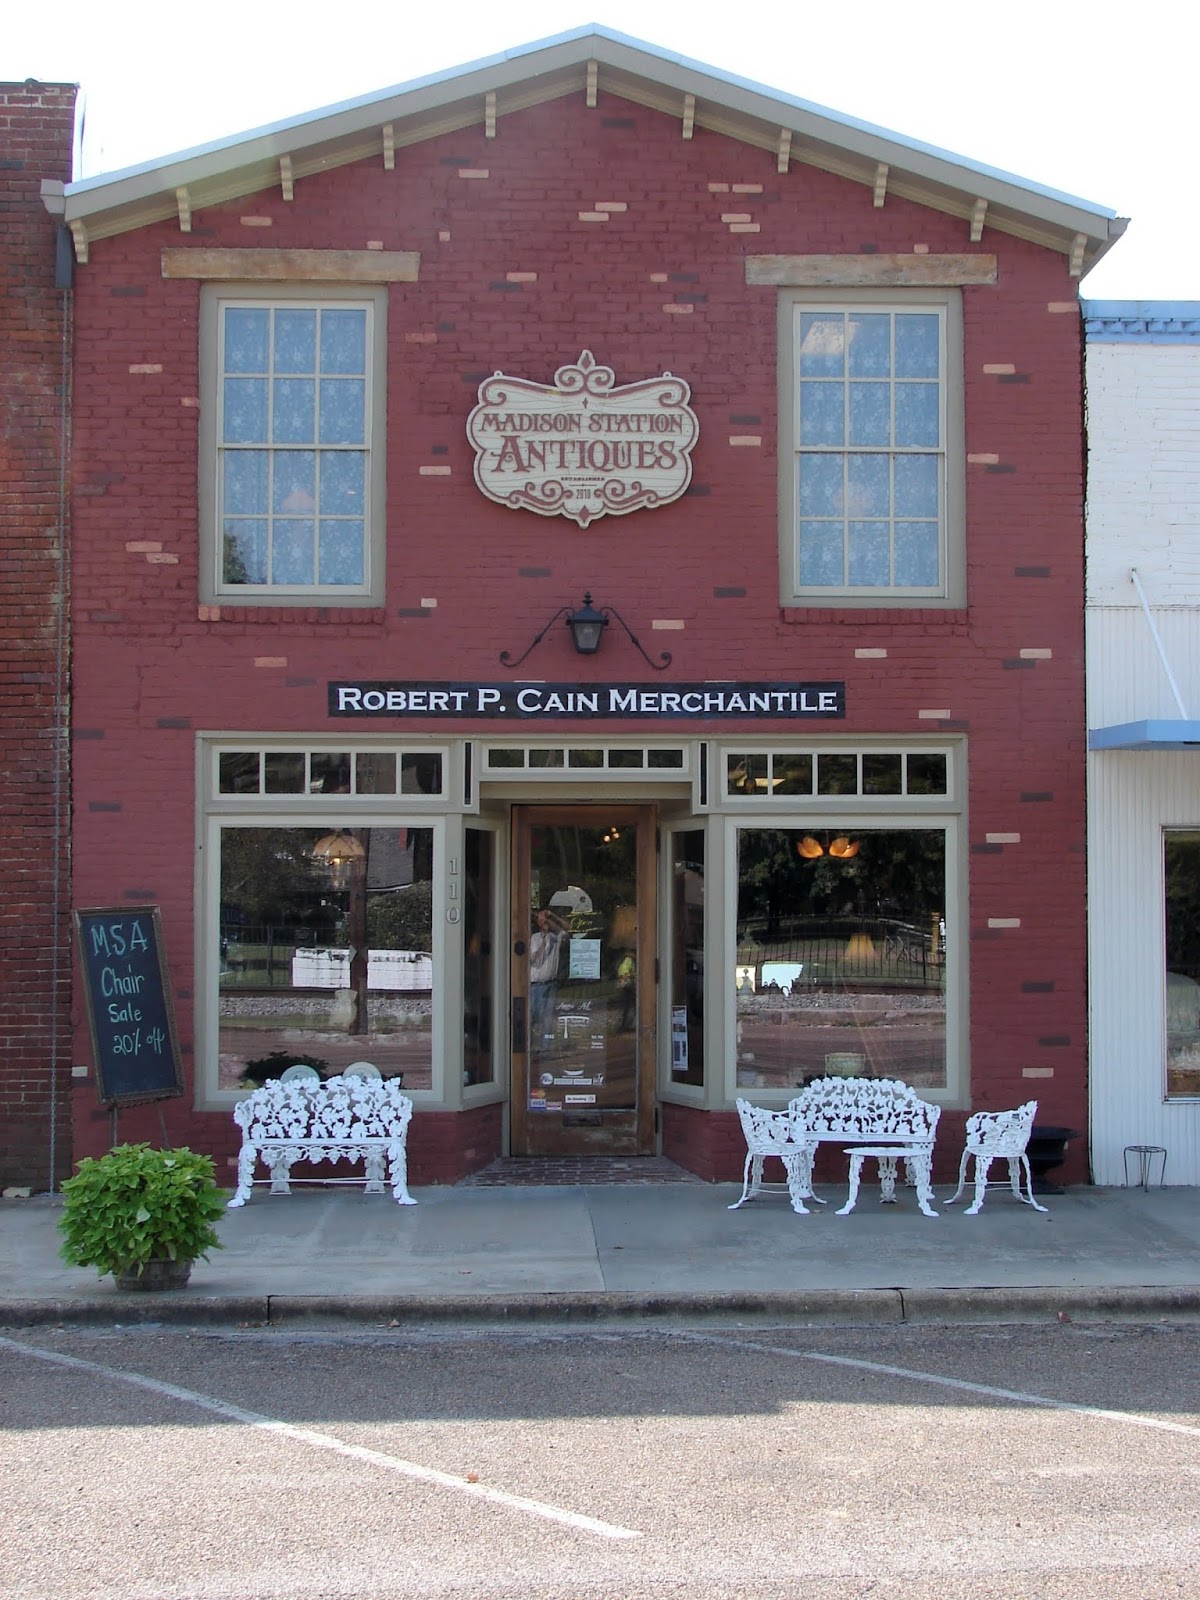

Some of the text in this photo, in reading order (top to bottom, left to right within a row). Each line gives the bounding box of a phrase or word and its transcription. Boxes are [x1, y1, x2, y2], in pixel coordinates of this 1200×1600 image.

[478, 413, 683, 434] MADISON STATION
[490, 435, 678, 473] ANTIQUES
[576, 488, 591, 500] 2010
[337, 687, 838, 712] ROBERT P. CAIN MERCHANTILE
[90, 919, 149, 957] MSA
[101, 963, 145, 997] Chair
[107, 1002, 143, 1023] Sale
[113, 1026, 165, 1057] 20% off
